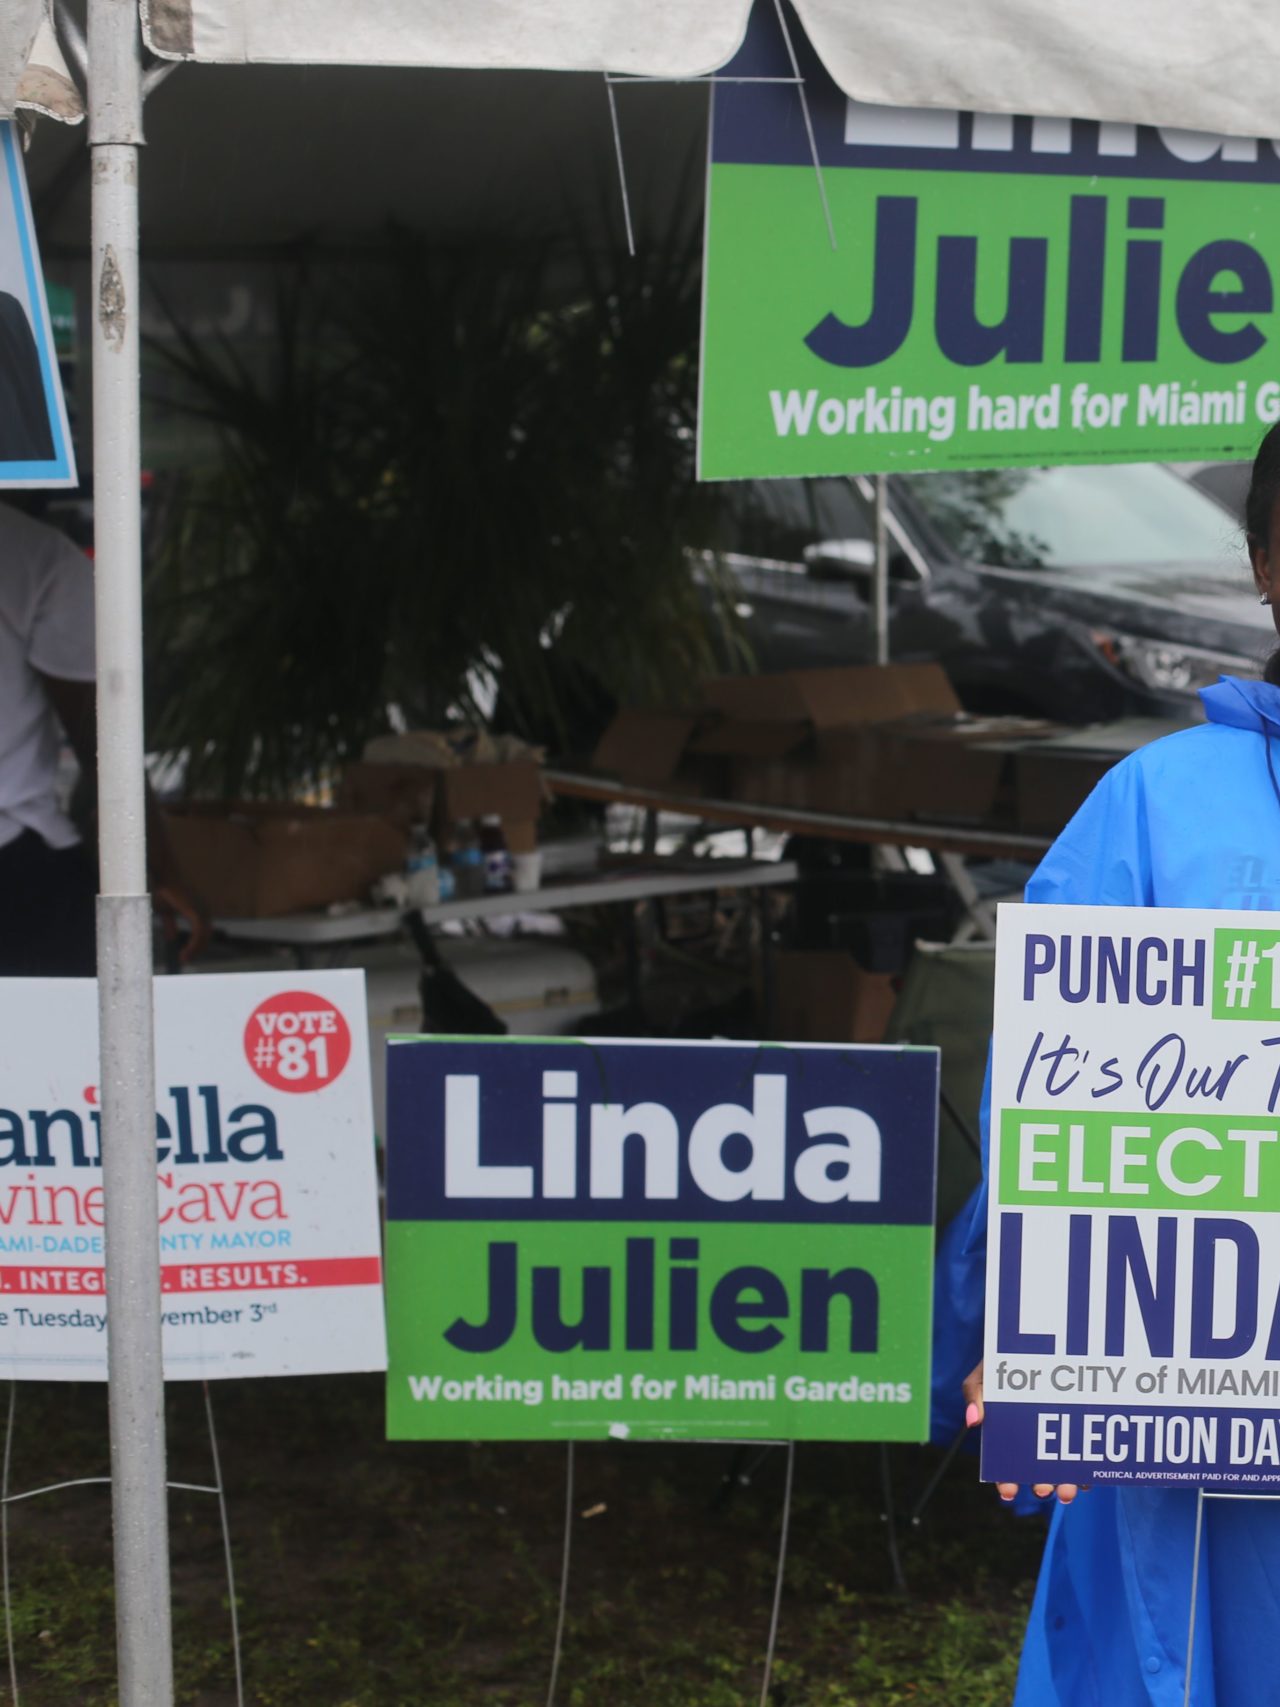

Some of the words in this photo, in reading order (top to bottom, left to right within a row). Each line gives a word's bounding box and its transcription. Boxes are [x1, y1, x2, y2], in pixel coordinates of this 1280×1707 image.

[769, 387, 956, 441] Working
[968, 384, 1061, 432] hard
[1070, 382, 1128, 428] for
[1137, 382, 1247, 426] Miami
[1023, 933, 1206, 1007] PUNCH
[256, 1010, 338, 1036] VOTE
[254, 1035, 329, 1080] #81
[1016, 1031, 1123, 1103] It's
[1136, 1033, 1249, 1111] Our
[445, 1070, 882, 1204] Linda
[1018, 1123, 1278, 1198] ELECT
[210, 1229, 291, 1250] MAYOR
[180, 1264, 308, 1289] RESULTS.
[442, 1237, 880, 1354] Julien
[250, 1302, 278, 1323] 3rd
[408, 1373, 542, 1406] Working
[551, 1374, 622, 1401] hard
[630, 1374, 677, 1400] for
[684, 1375, 776, 1400] Miami
[784, 1375, 912, 1403] Gardens
[996, 1361, 1042, 1390] for
[1050, 1365, 1127, 1393] CITY
[1135, 1365, 1168, 1395] of
[1177, 1368, 1279, 1397] MIAMI
[1036, 1412, 1218, 1465] ELECTION
[1093, 1470, 1134, 1479] POLITICAL
[1135, 1472, 1200, 1481] ADVERTISEMENT
[1202, 1473, 1220, 1481] PAID
[1223, 1473, 1240, 1482] FOR
[1241, 1474, 1259, 1482] AND
